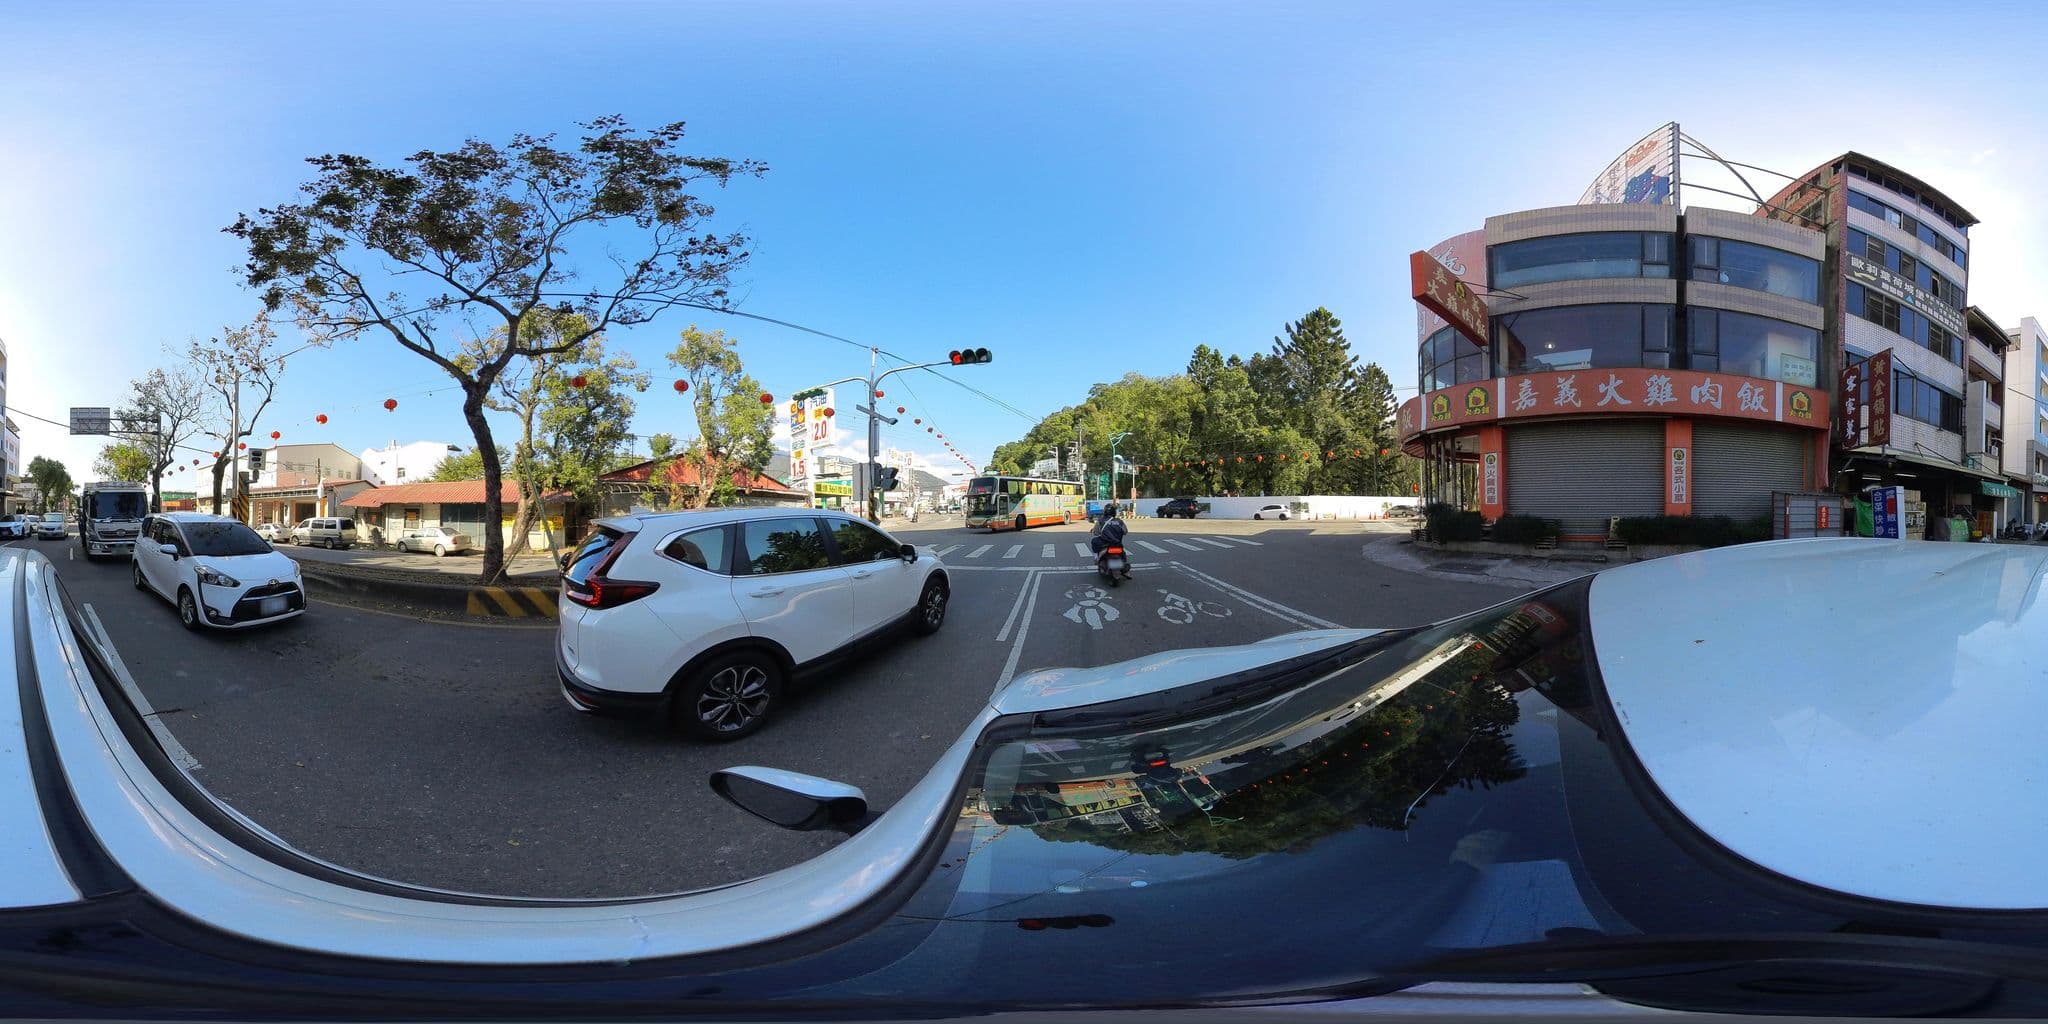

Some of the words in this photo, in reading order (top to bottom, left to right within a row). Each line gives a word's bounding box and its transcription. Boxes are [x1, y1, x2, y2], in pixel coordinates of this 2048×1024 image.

[1512, 373, 1769, 414] 嘉義火雞肉飯
